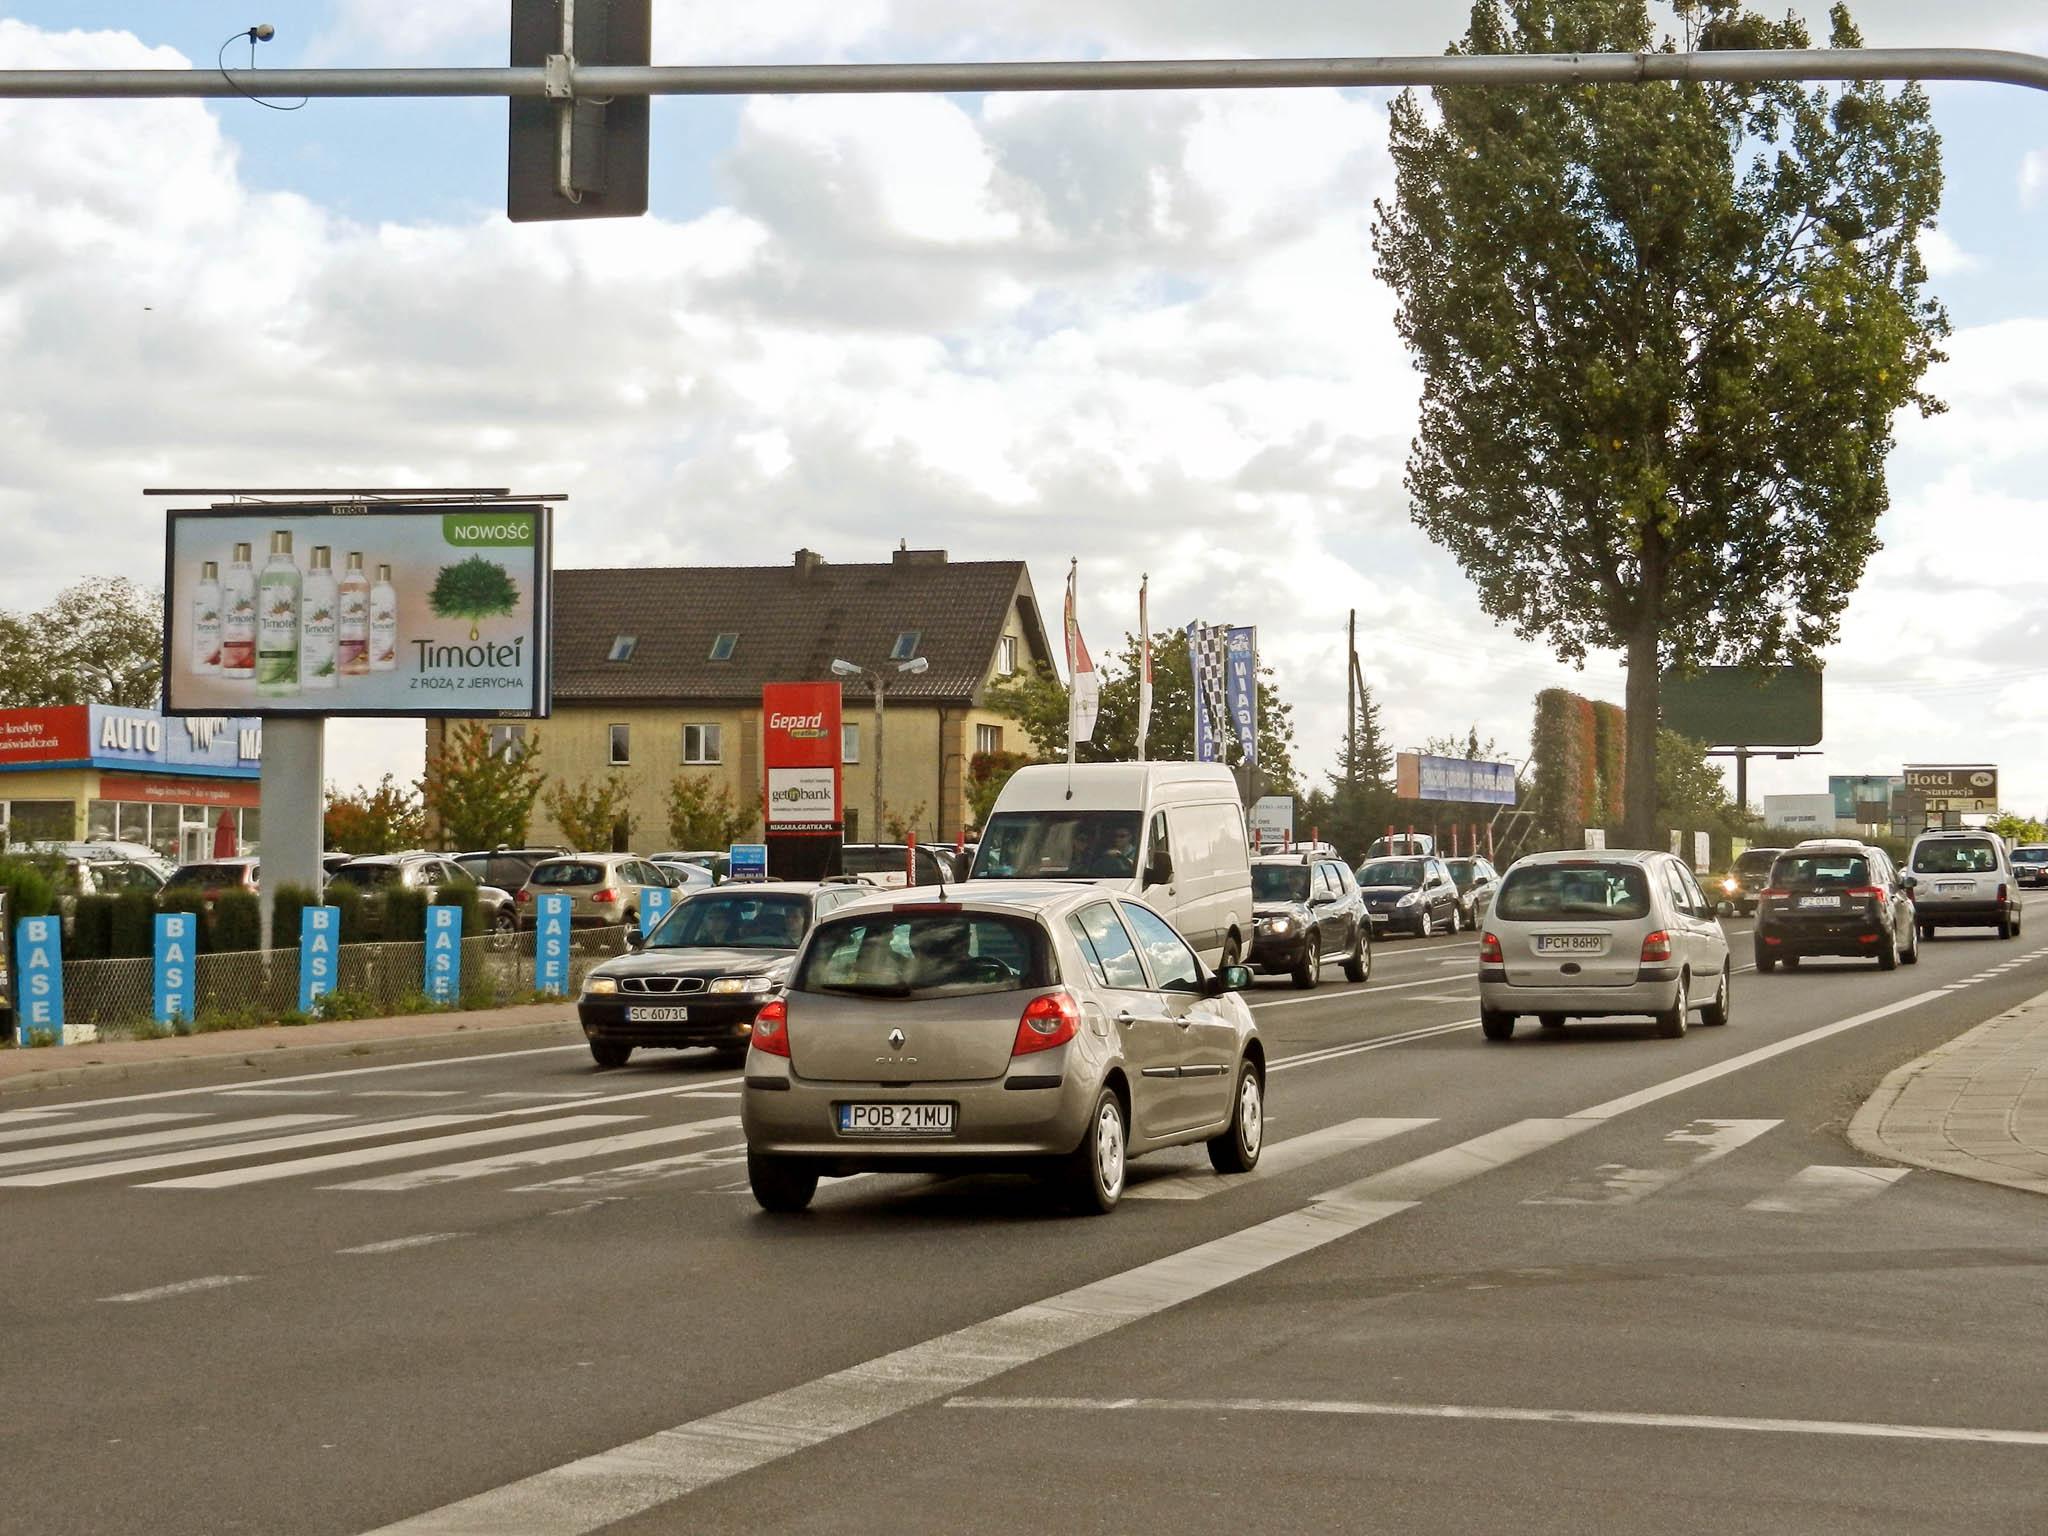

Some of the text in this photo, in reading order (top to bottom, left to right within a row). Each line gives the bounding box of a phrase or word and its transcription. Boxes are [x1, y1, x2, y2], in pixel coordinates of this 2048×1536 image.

[454, 522, 530, 540] NOWOŚĆ
[411, 635, 525, 673] Timotei
[409, 678, 418, 689] Z
[457, 678, 465, 689] Z
[467, 676, 524, 689] JERYCHA
[6, 721, 45, 735] kredyty
[770, 712, 823, 732] Gepard
[101, 715, 161, 753] AUTO
[1906, 771, 1953, 786] Hotel
[1914, 787, 1974, 797] stauracja
[1545, 937, 1599, 949] PCH 86H9
[631, 1008, 687, 1020] SC 6073C
[853, 1106, 949, 1126] POB 21MU
